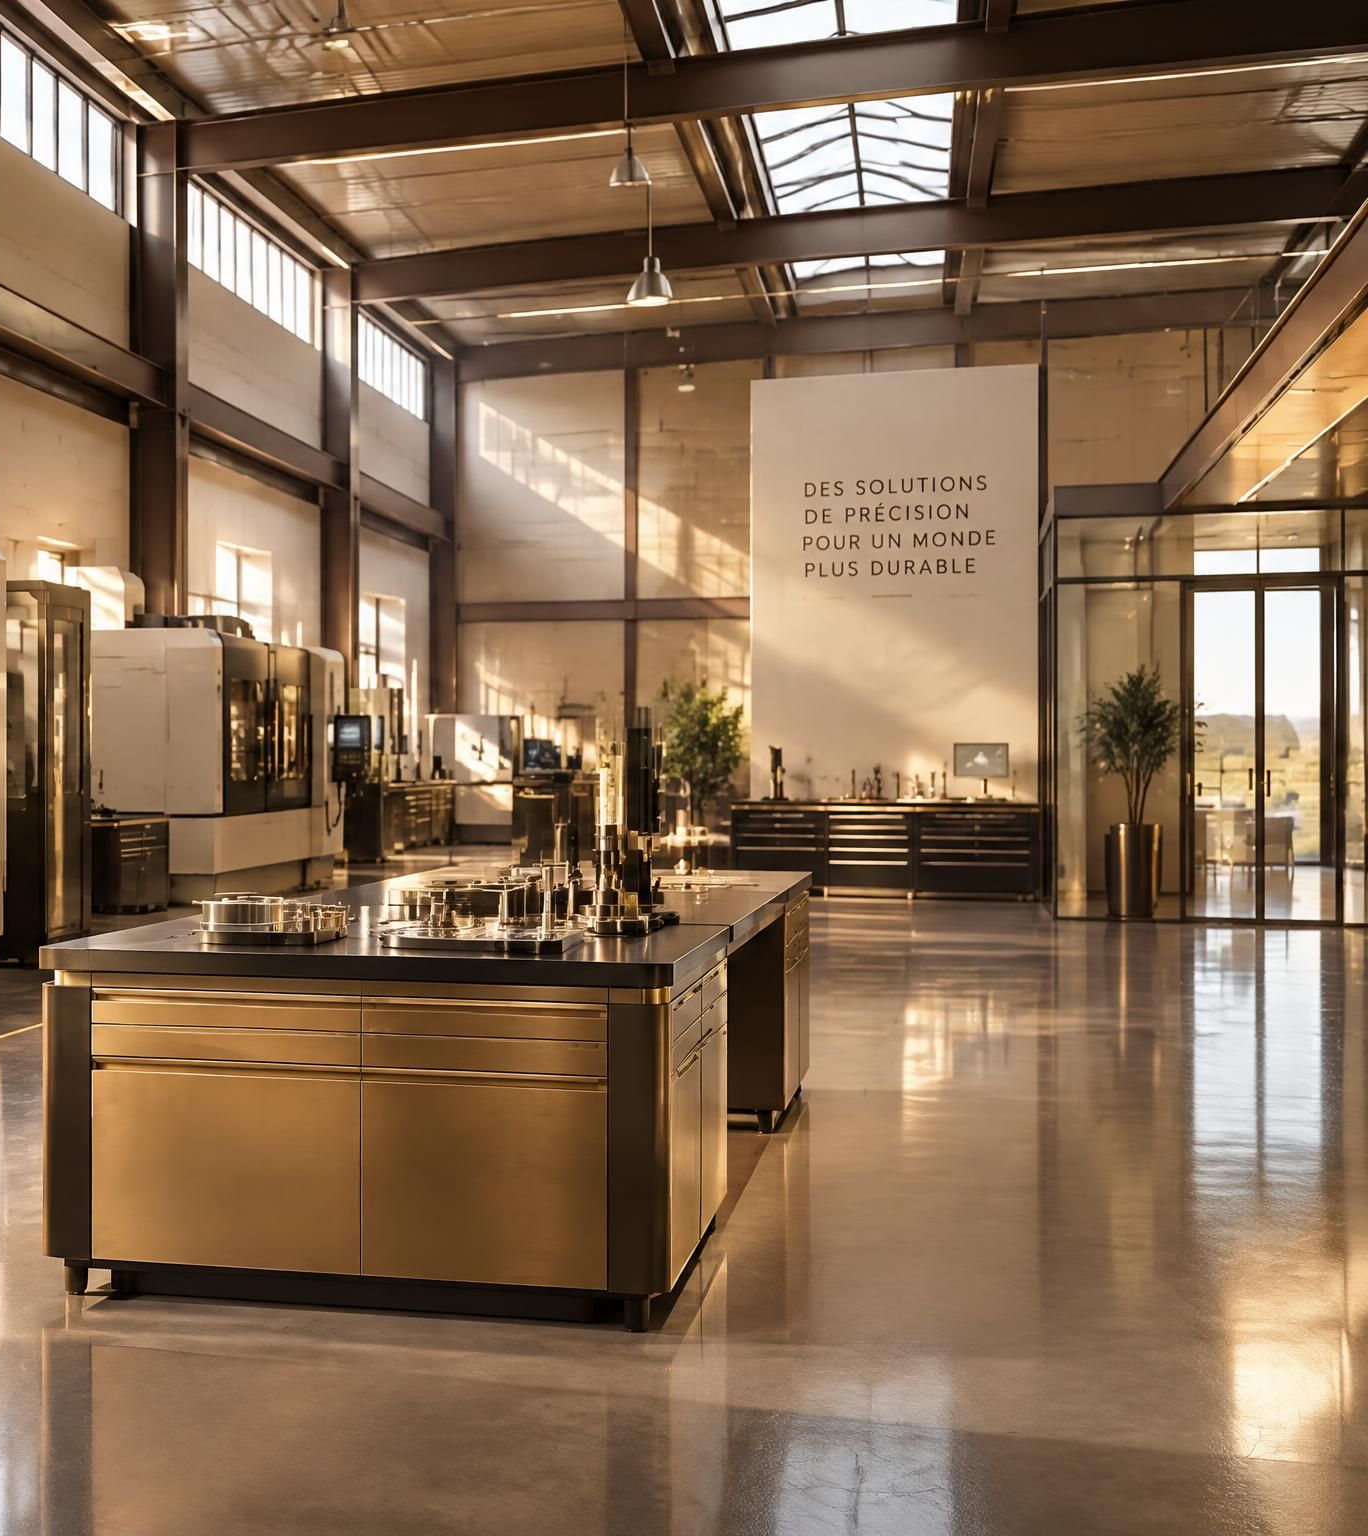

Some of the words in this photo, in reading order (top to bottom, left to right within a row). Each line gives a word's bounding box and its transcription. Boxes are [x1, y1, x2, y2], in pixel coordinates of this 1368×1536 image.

[805, 481, 844, 497] DES
[856, 475, 987, 495] SOLUTIONS
[805, 509, 832, 524] DE
[845, 503, 969, 523] PRÉCISION
[803, 535, 860, 551] POUR
[872, 534, 901, 548] UN
[914, 530, 996, 548] MONDE
[805, 561, 858, 577] PLUS
[871, 558, 976, 576] DURABLE
